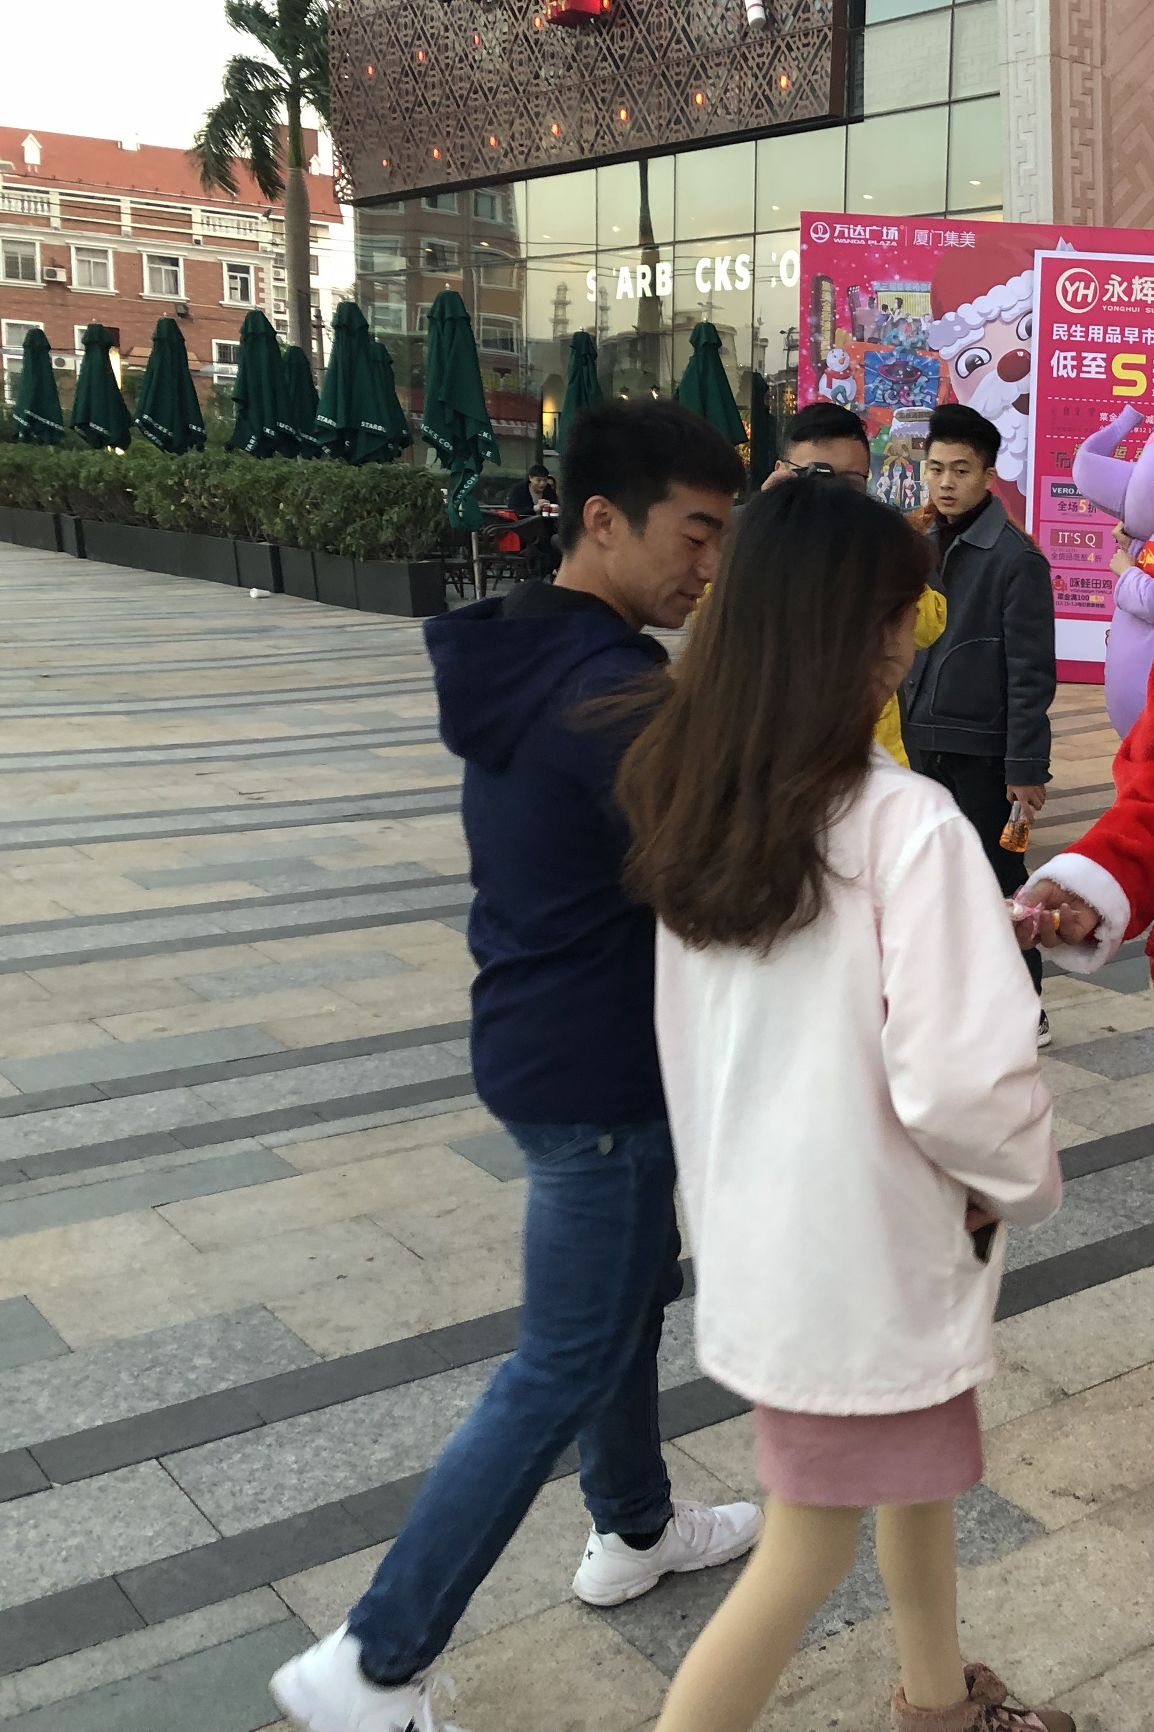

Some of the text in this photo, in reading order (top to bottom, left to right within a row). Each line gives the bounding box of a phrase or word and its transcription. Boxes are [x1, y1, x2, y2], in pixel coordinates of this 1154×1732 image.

[833, 223, 899, 239] 万达广场
[913, 229, 976, 248] 厦门集美
[868, 239, 898, 247] PLAZA
[586, 253, 751, 302] SARBCKS
[1063, 280, 1096, 303] YH
[1102, 304, 1141, 313] YONGHUI
[1052, 487, 1075, 495] VERO
[1058, 531, 1096, 548] IT'S Q
